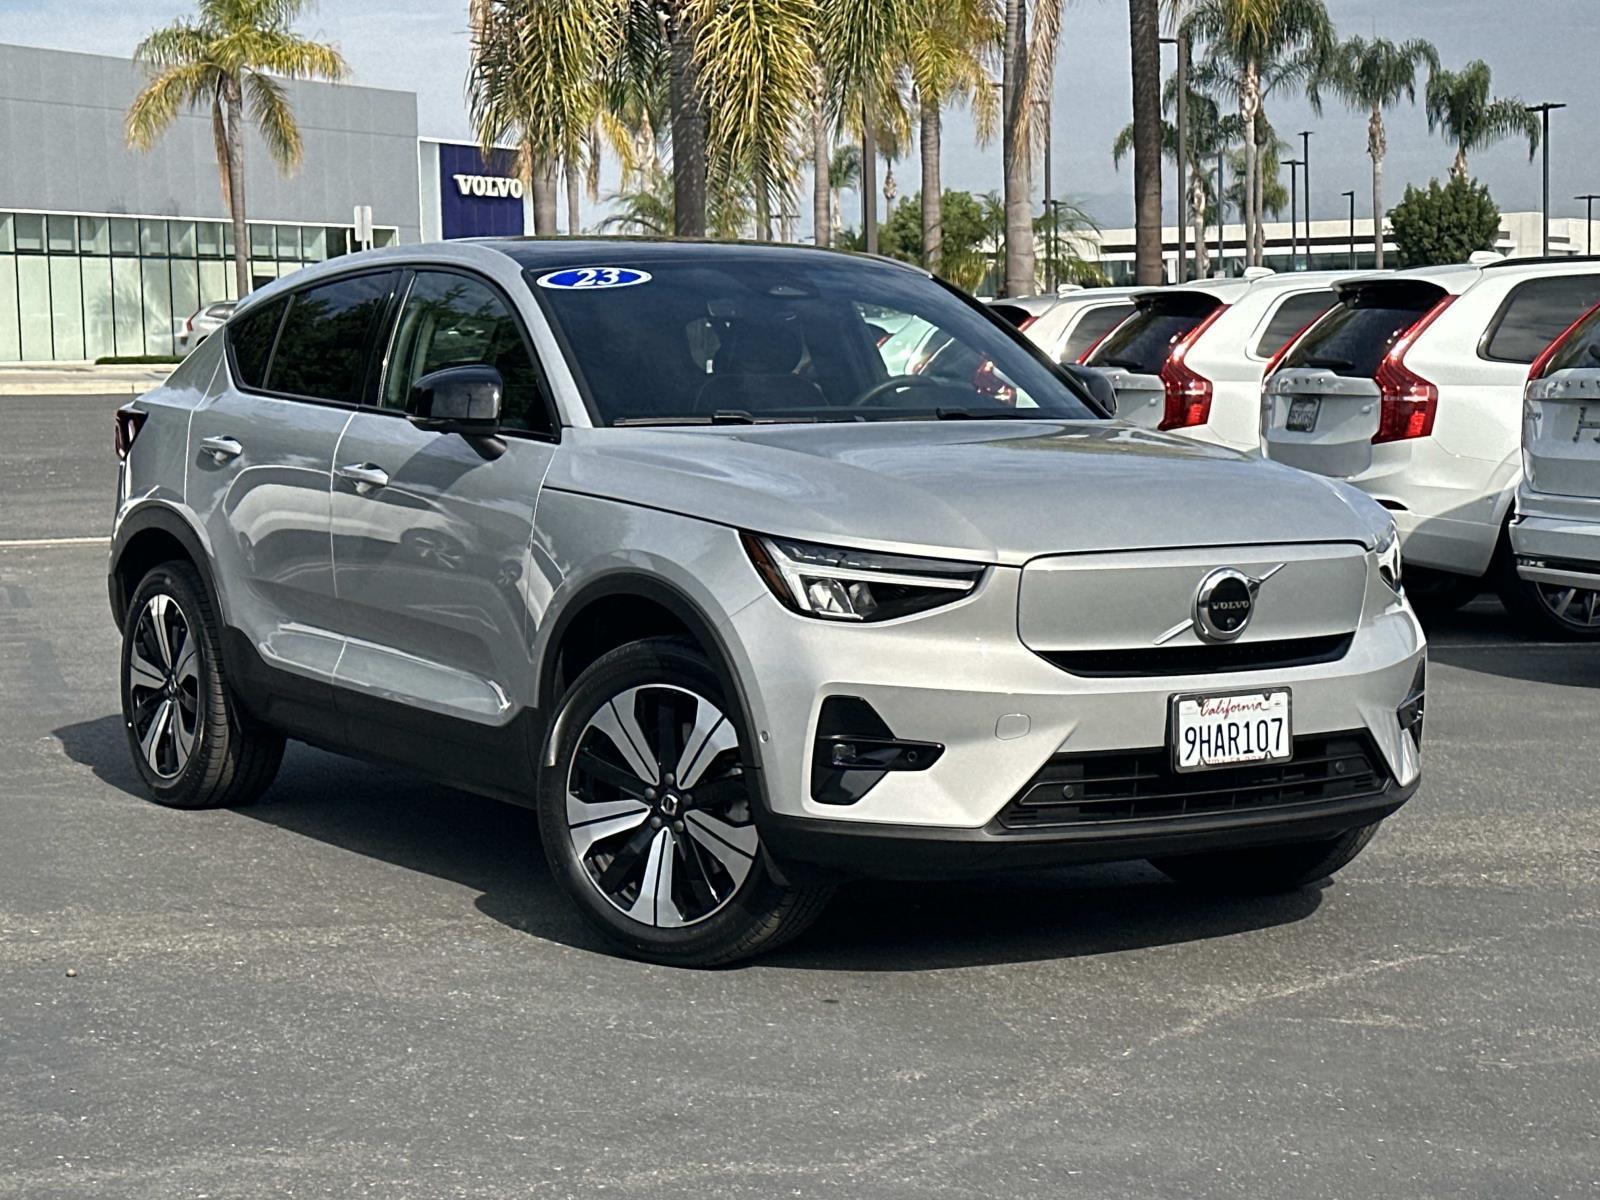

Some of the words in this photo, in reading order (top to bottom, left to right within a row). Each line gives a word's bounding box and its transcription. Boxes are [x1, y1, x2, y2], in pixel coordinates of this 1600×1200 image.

[453, 174, 523, 199] VOLVO
[573, 269, 620, 287] 23
[1211, 600, 1250, 610] VOLVO
[1201, 699, 1269, 719] California
[1184, 717, 1283, 761] 9HAR107
